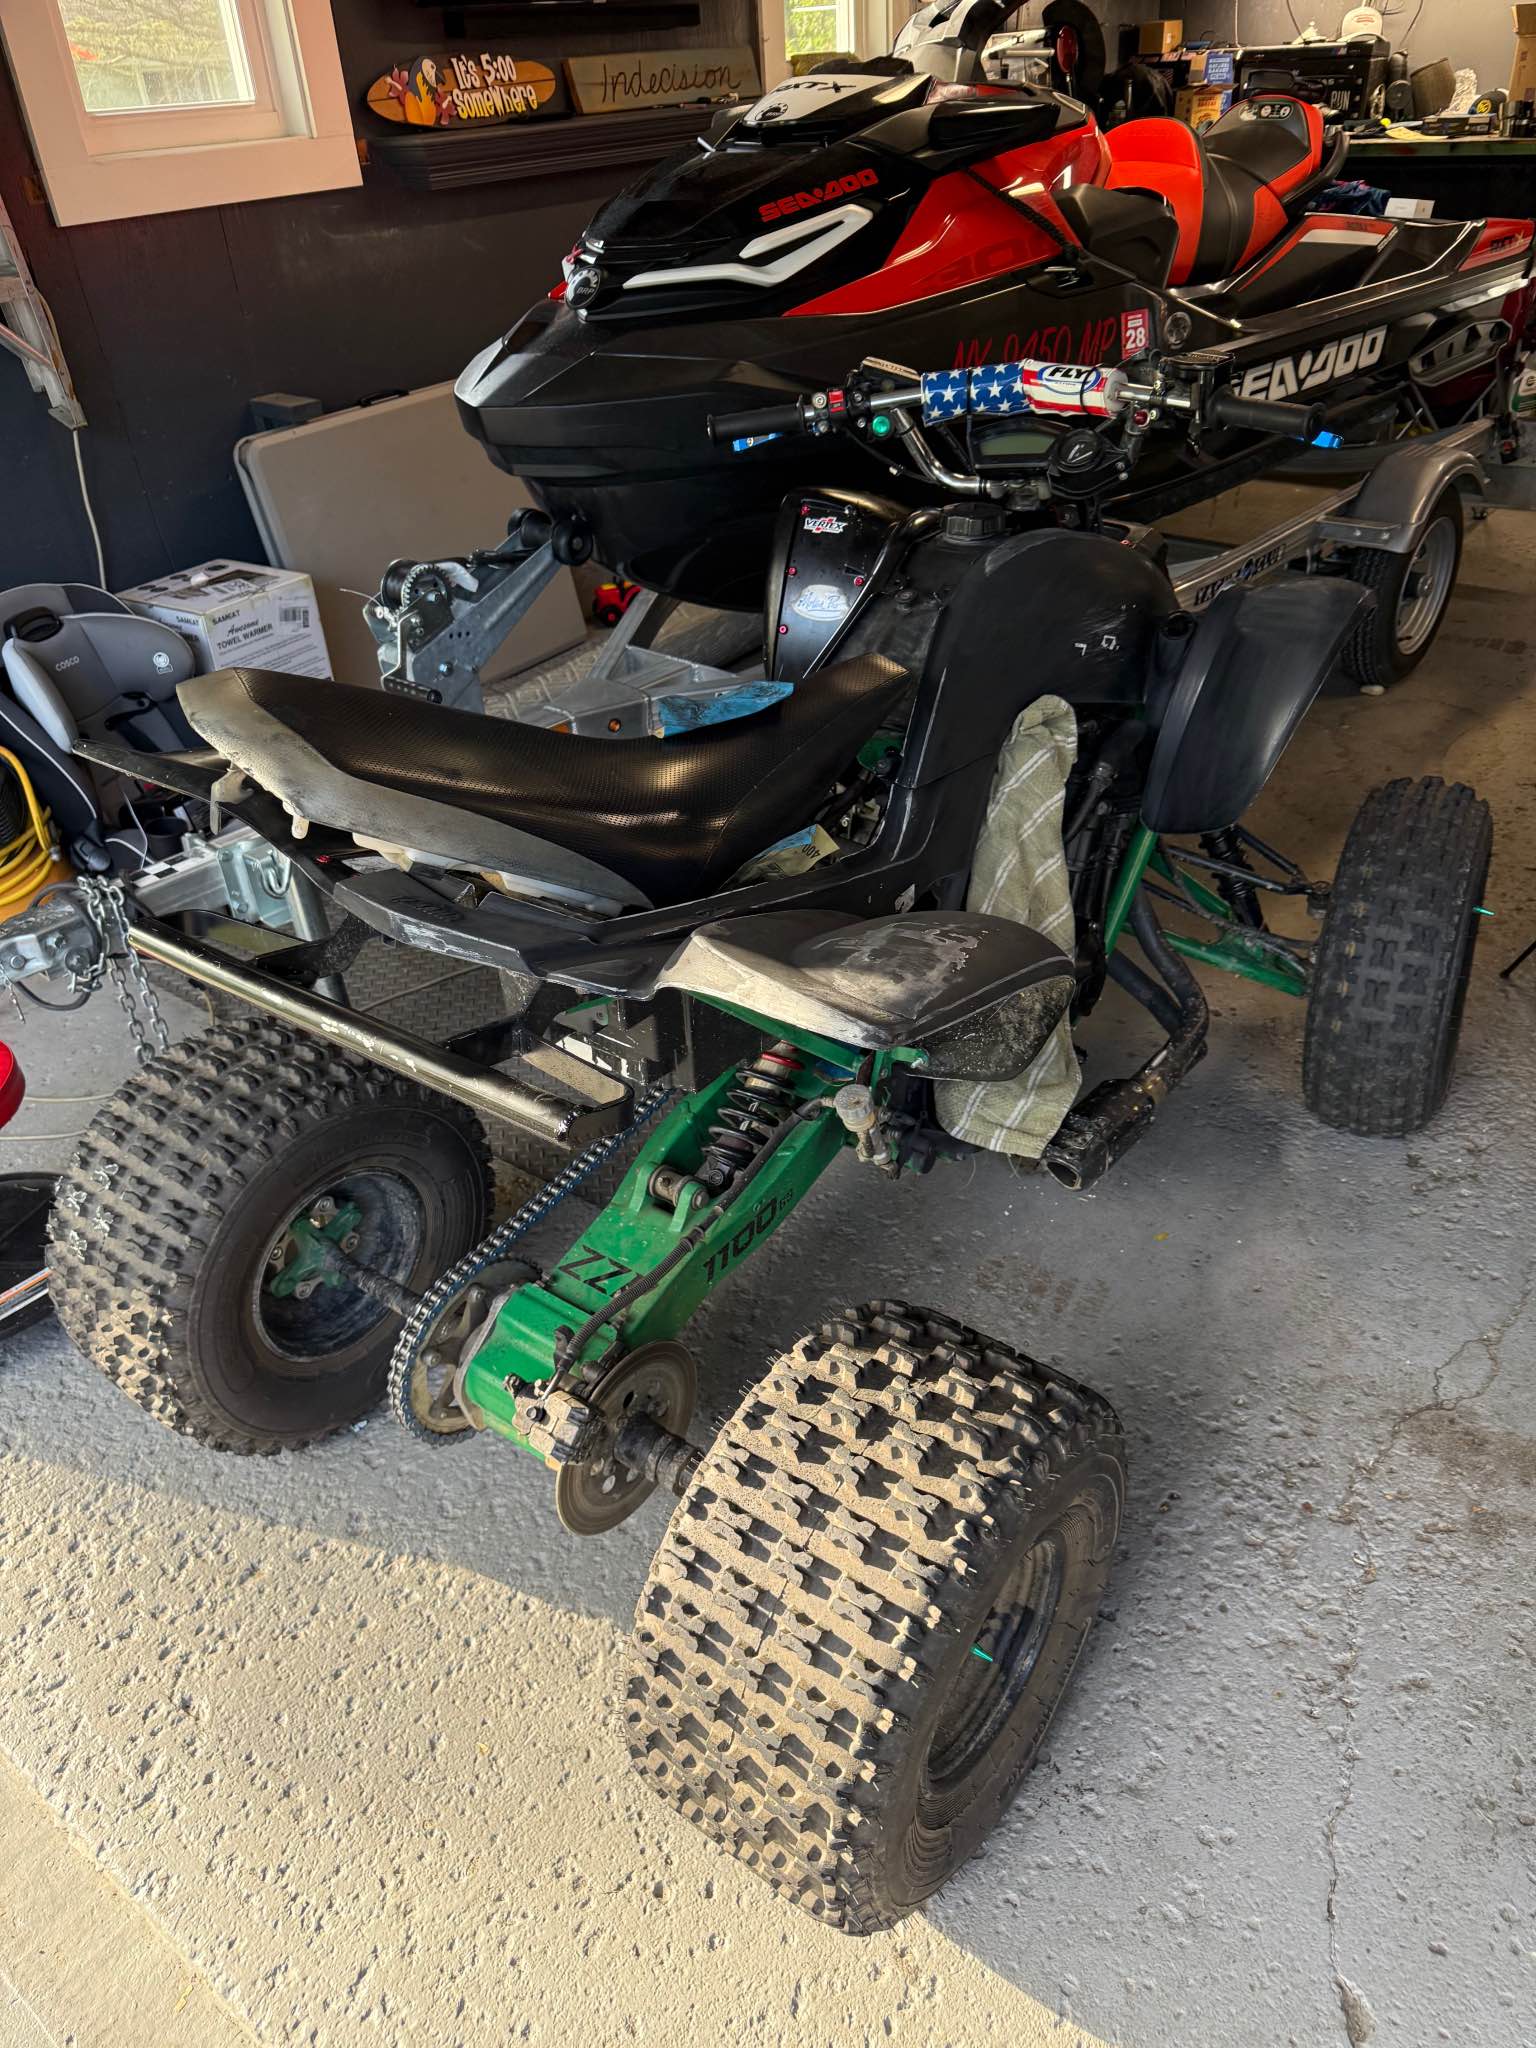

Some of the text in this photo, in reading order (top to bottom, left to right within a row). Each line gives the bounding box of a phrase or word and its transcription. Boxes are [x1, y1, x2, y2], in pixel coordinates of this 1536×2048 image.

[451, 53, 517, 89] It's 5:00
[602, 59, 741, 103] Indecision
[1126, 327, 1146, 349] 28
[1048, 367, 1091, 379] FLY
[805, 518, 846, 531] VERTEX
[217, 636, 241, 650] TOWEL
[243, 623, 273, 641] WARMER
[55, 655, 80, 672] COSCO
